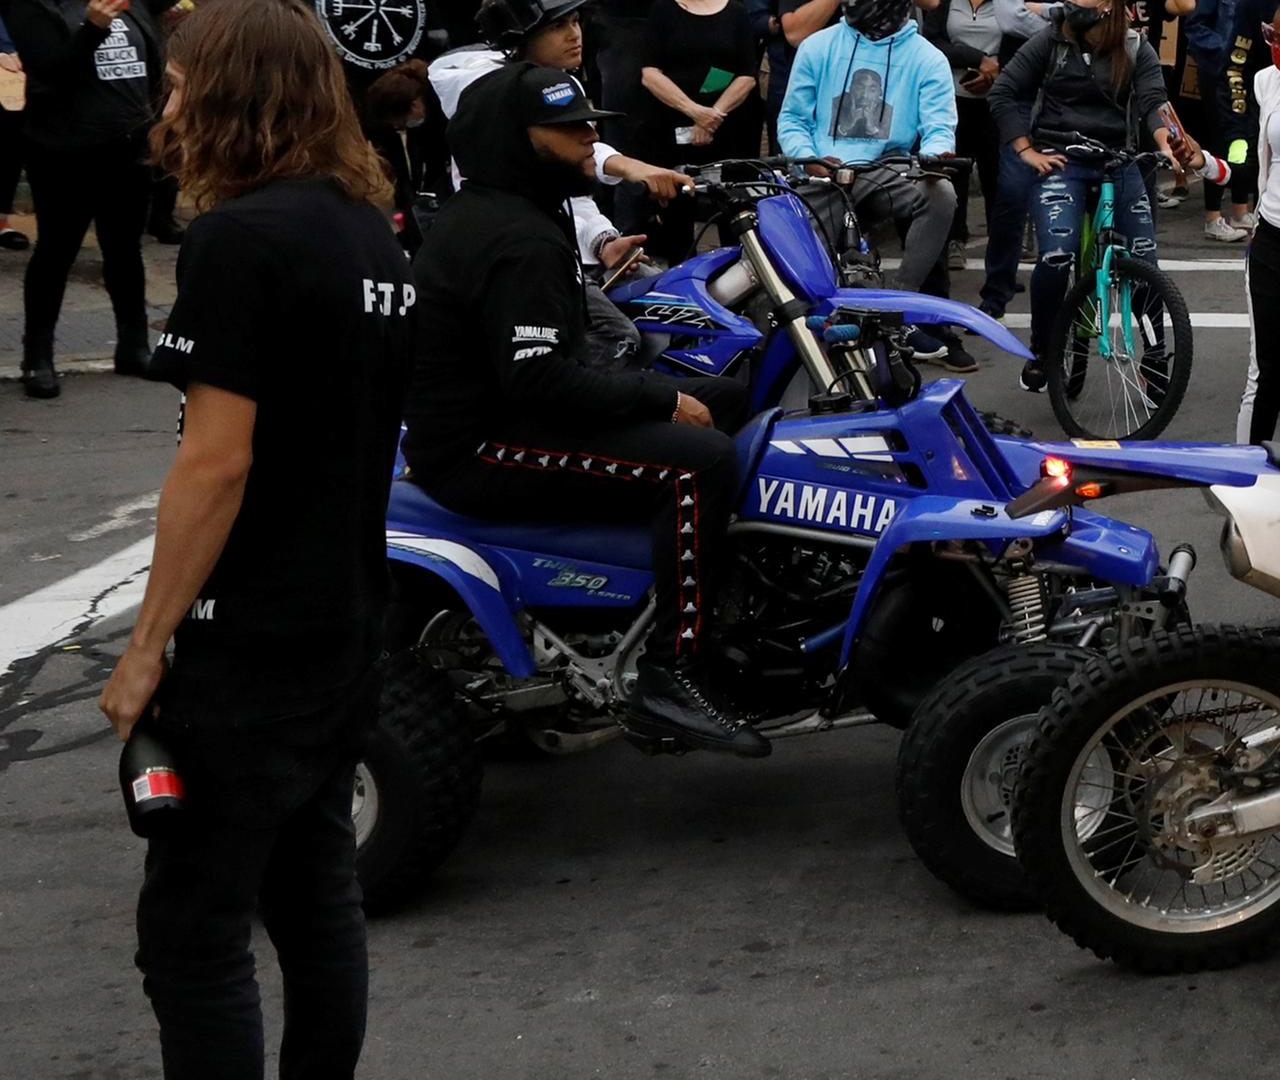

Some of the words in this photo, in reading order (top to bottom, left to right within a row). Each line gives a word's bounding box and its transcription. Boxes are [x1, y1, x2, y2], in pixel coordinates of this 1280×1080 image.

[97, 50, 135, 62] BLACK
[758, 478, 896, 532] YAMAHA
[551, 572, 608, 590] 350
